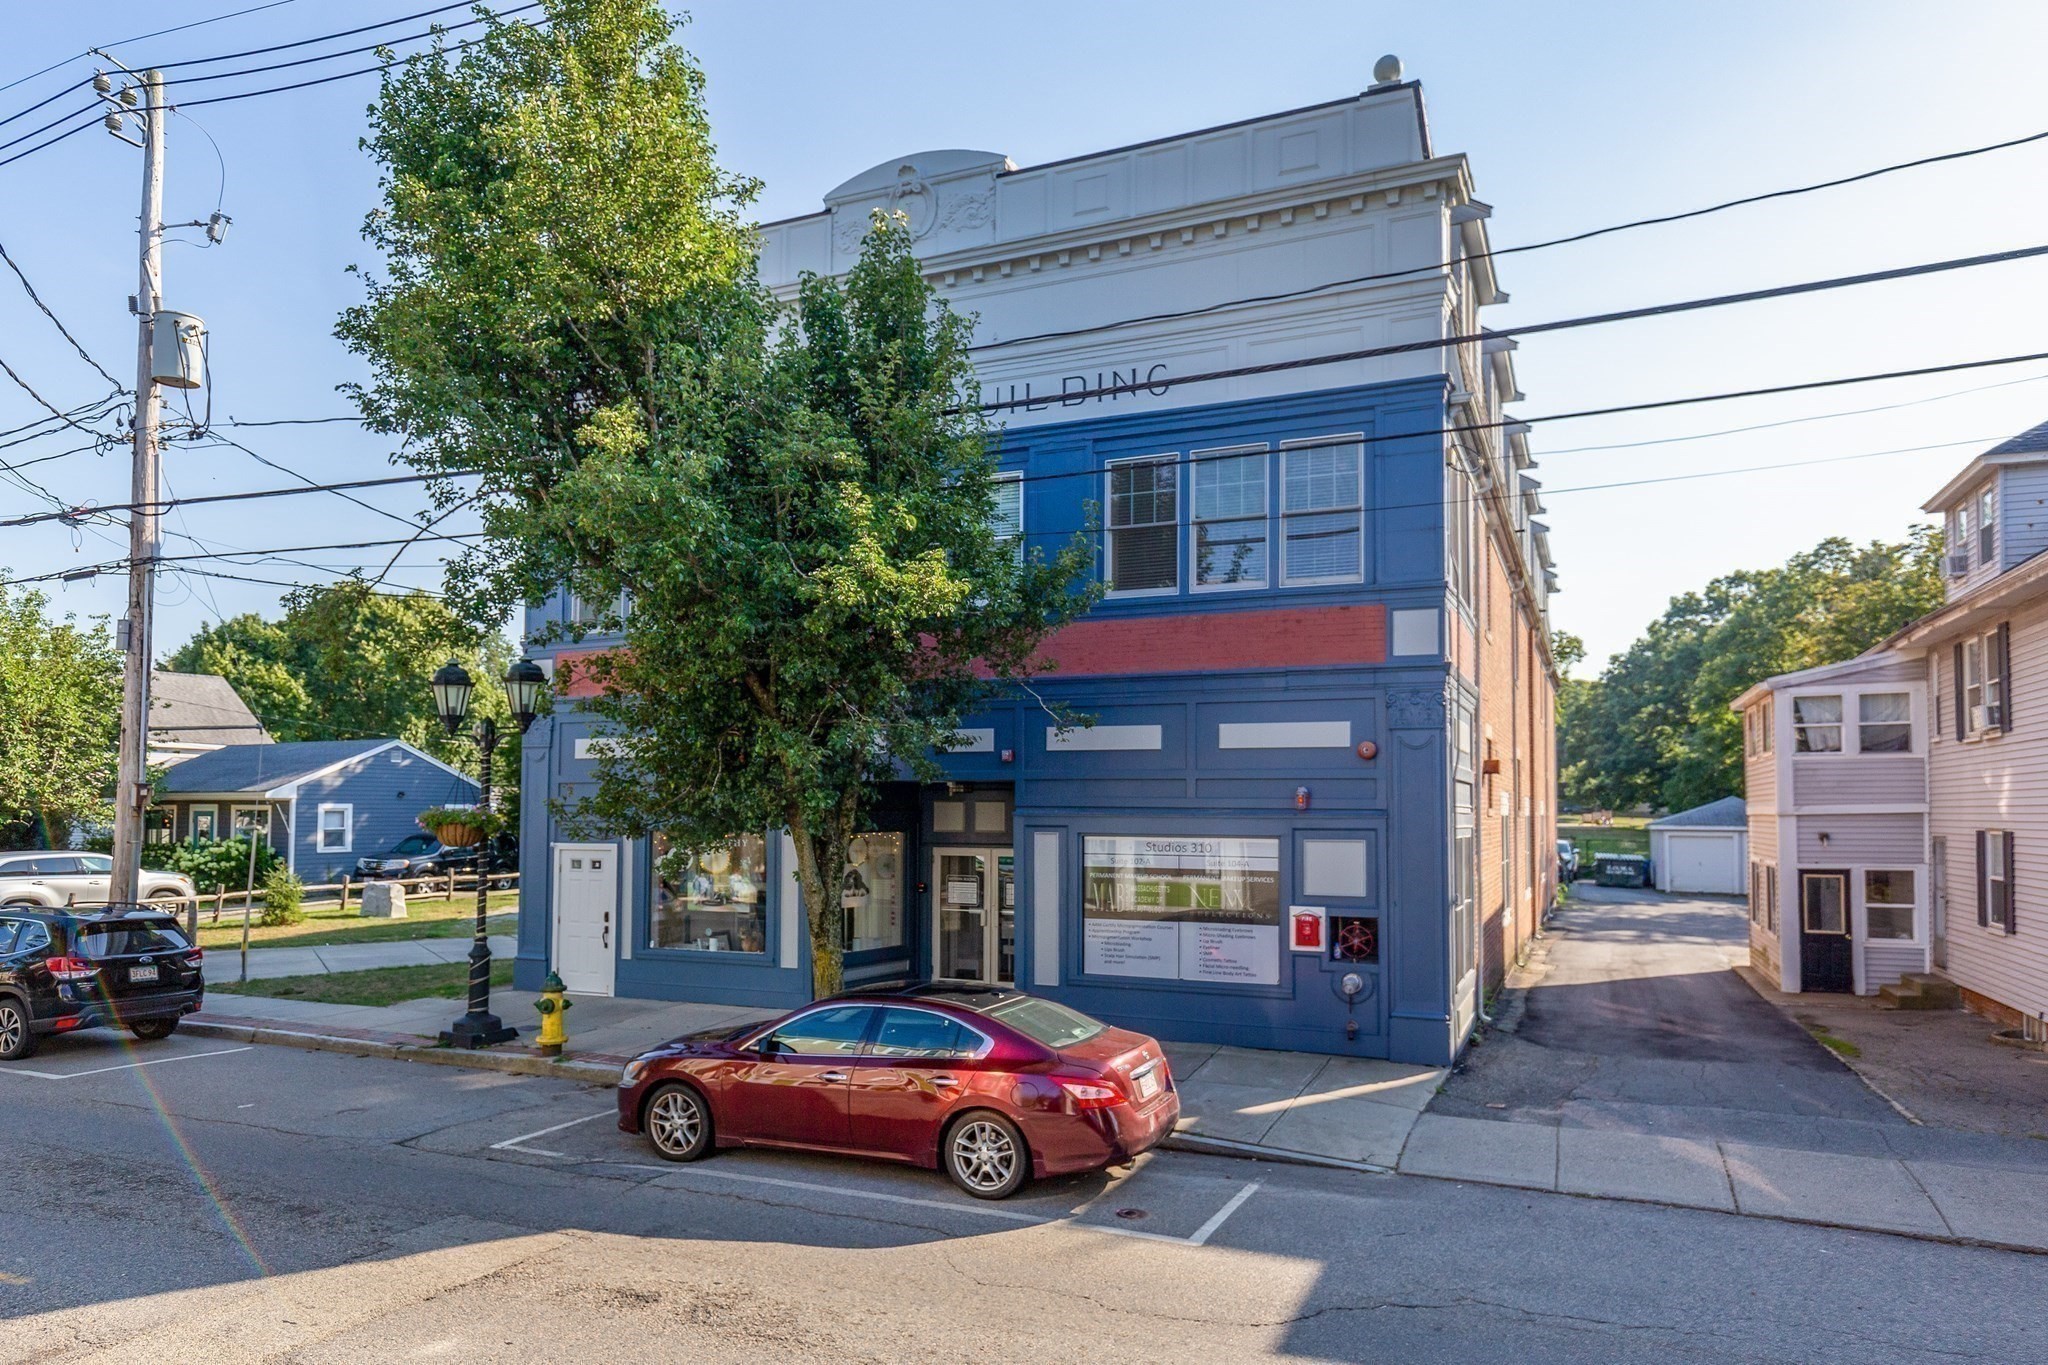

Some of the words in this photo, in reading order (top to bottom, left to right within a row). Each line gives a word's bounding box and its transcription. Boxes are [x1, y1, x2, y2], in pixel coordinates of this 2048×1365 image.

[1145, 841, 1187, 853] Studios
[1190, 842, 1212, 854] 310
[1206, 858, 1226, 867] Suite
